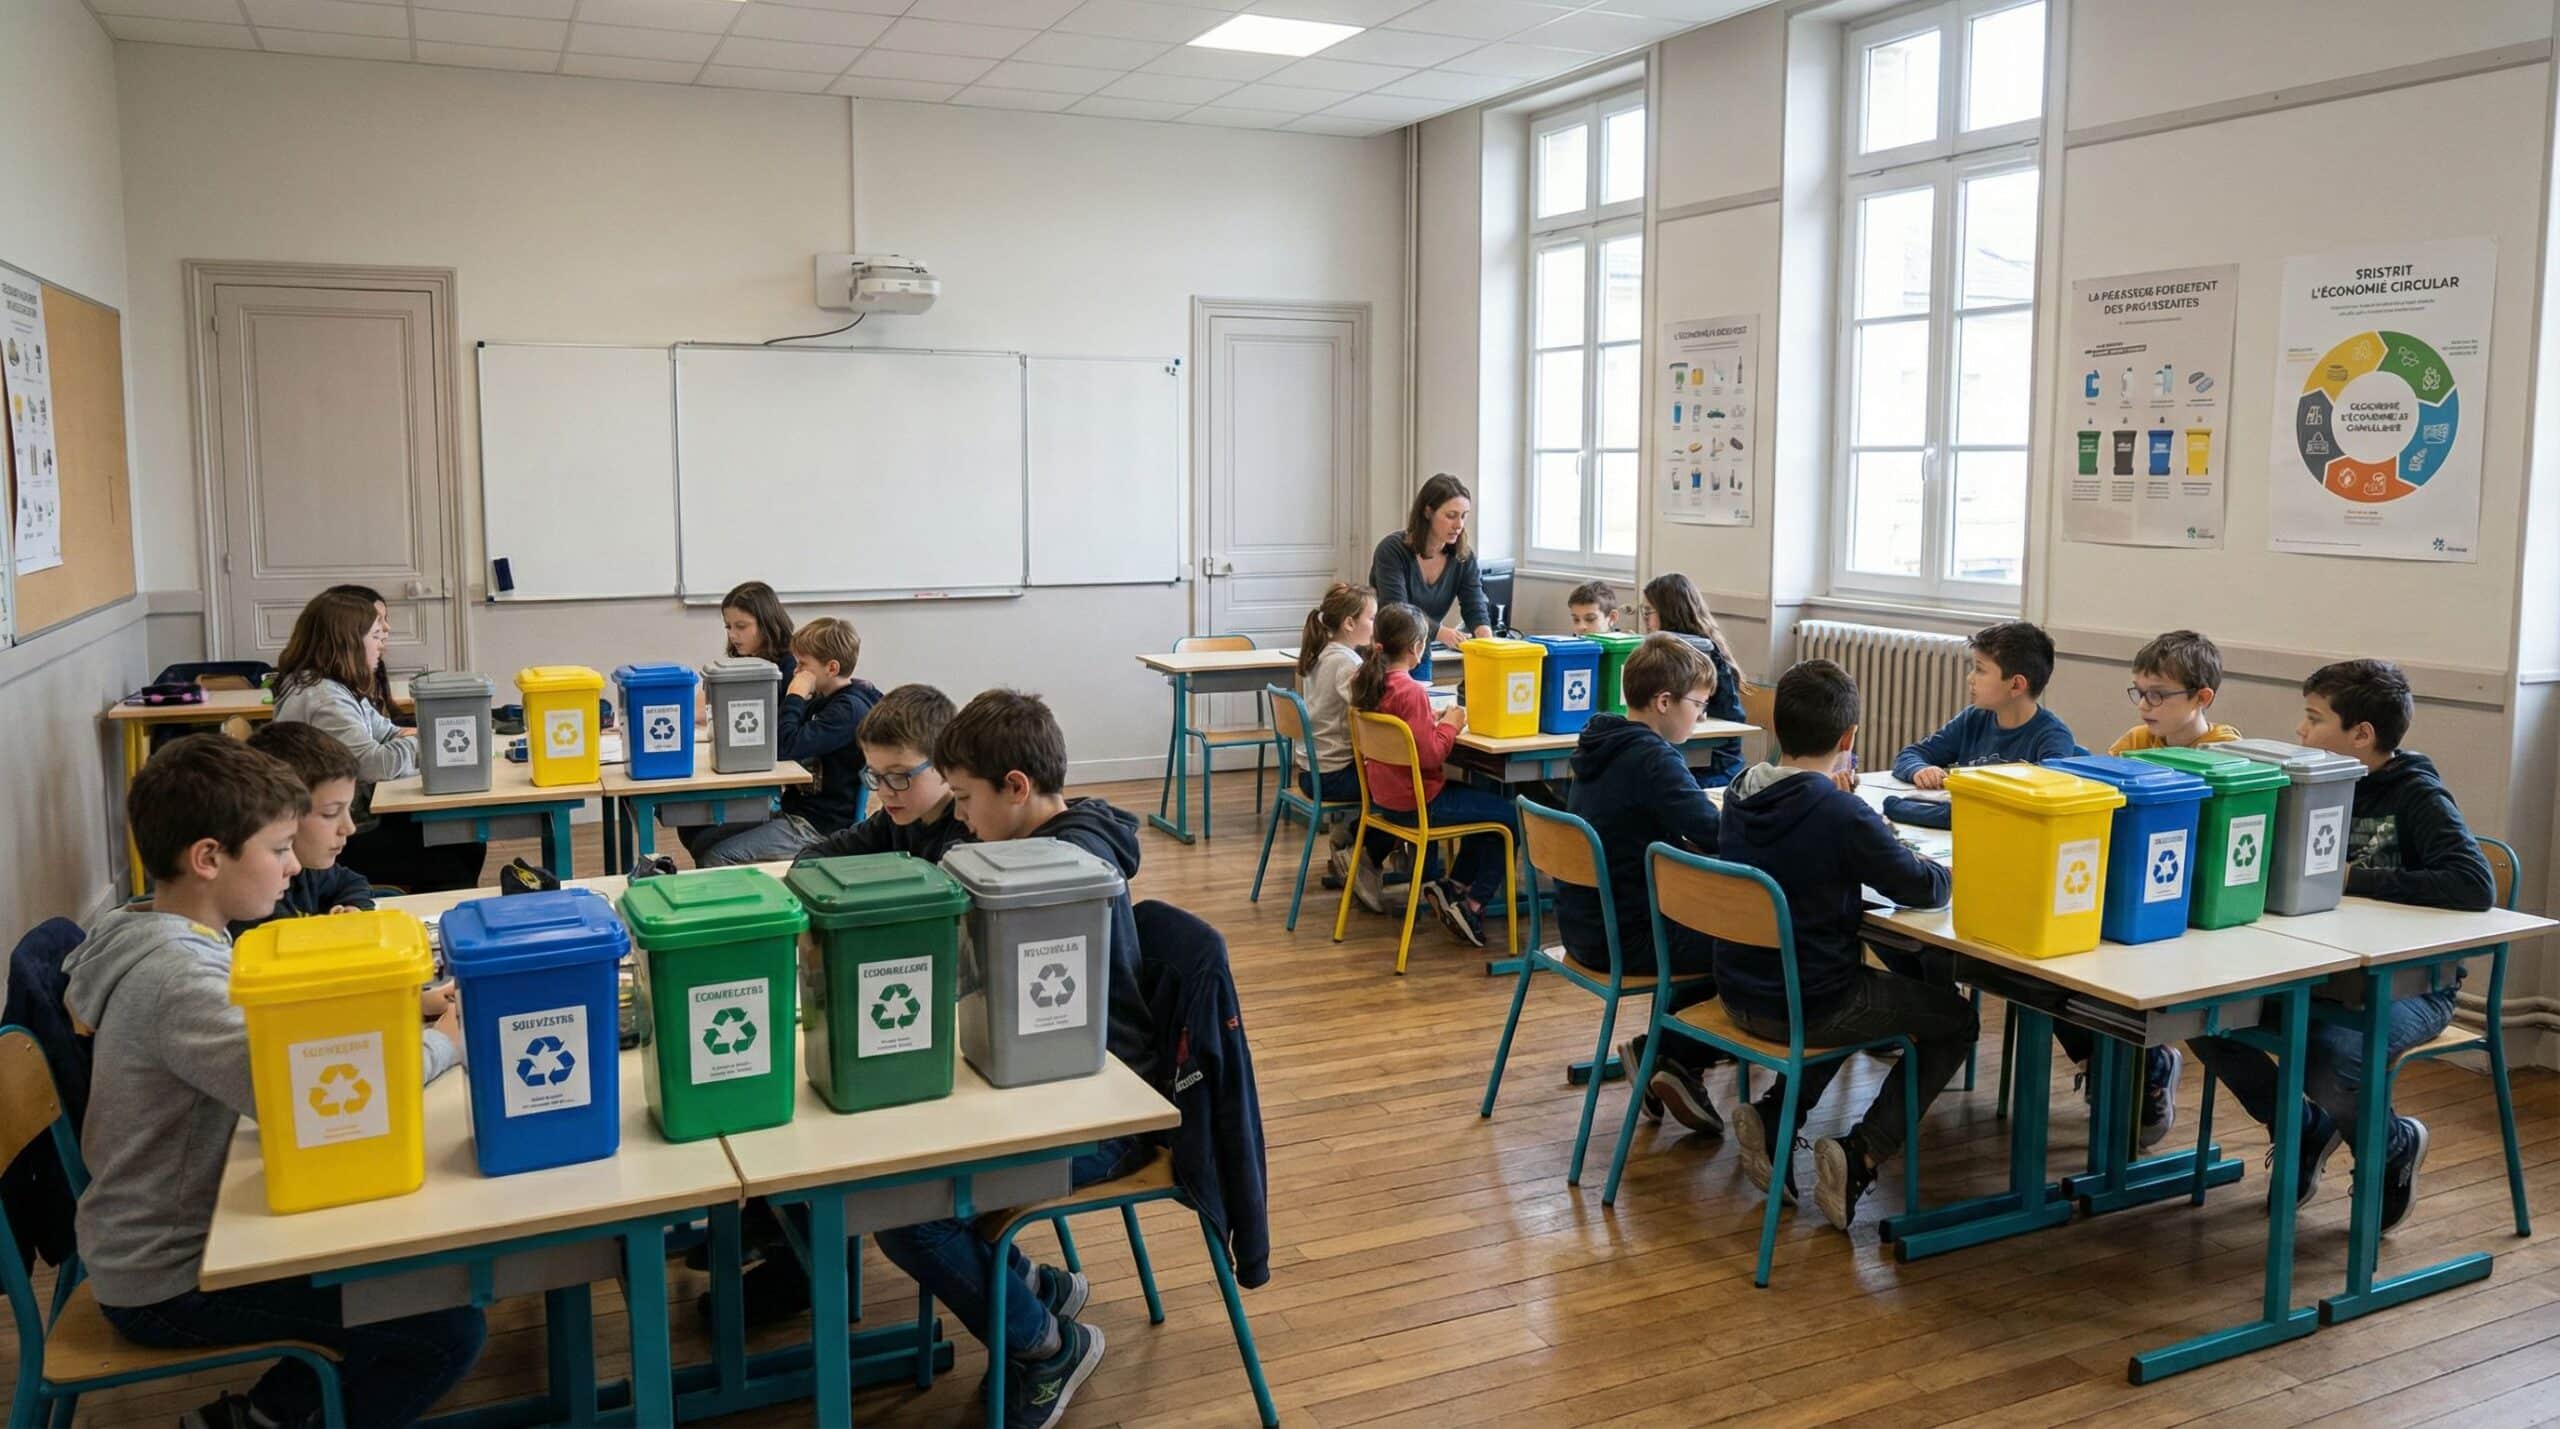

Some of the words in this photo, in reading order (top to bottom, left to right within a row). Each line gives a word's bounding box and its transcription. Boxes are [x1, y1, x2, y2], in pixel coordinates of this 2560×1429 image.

[2356, 264, 2414, 281] SRISTRIT
[2390, 276, 2460, 293] CIRCULAR
[2104, 304, 2123, 315] DES
